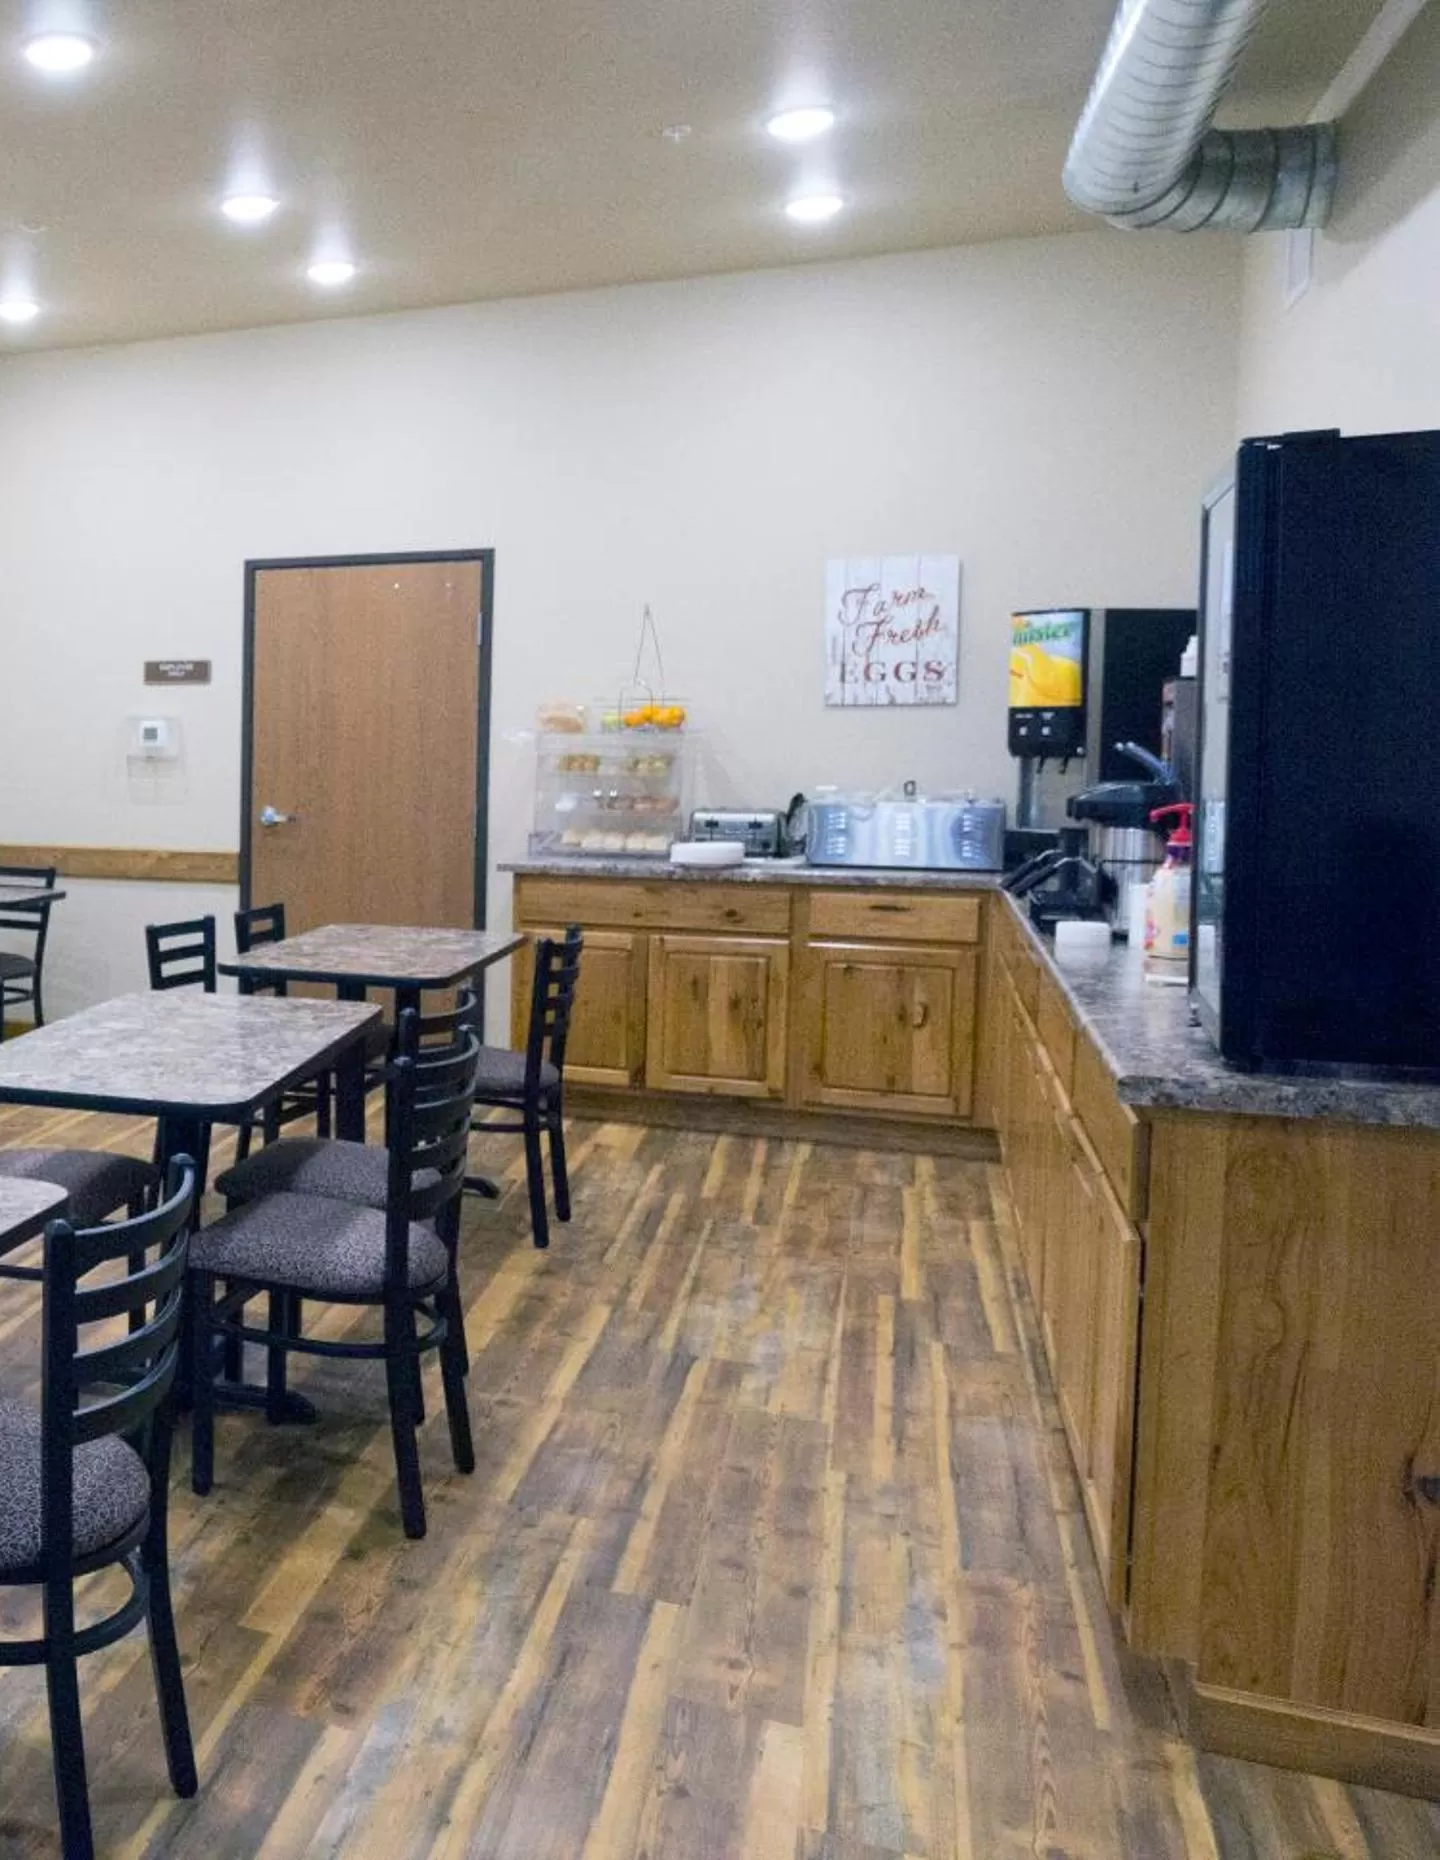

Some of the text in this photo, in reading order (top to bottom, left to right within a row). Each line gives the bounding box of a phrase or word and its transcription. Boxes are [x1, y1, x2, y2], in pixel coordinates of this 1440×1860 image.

[838, 583, 935, 625] Farm
[852, 604, 948, 656] Fresh
[840, 660, 946, 684] EGGS
